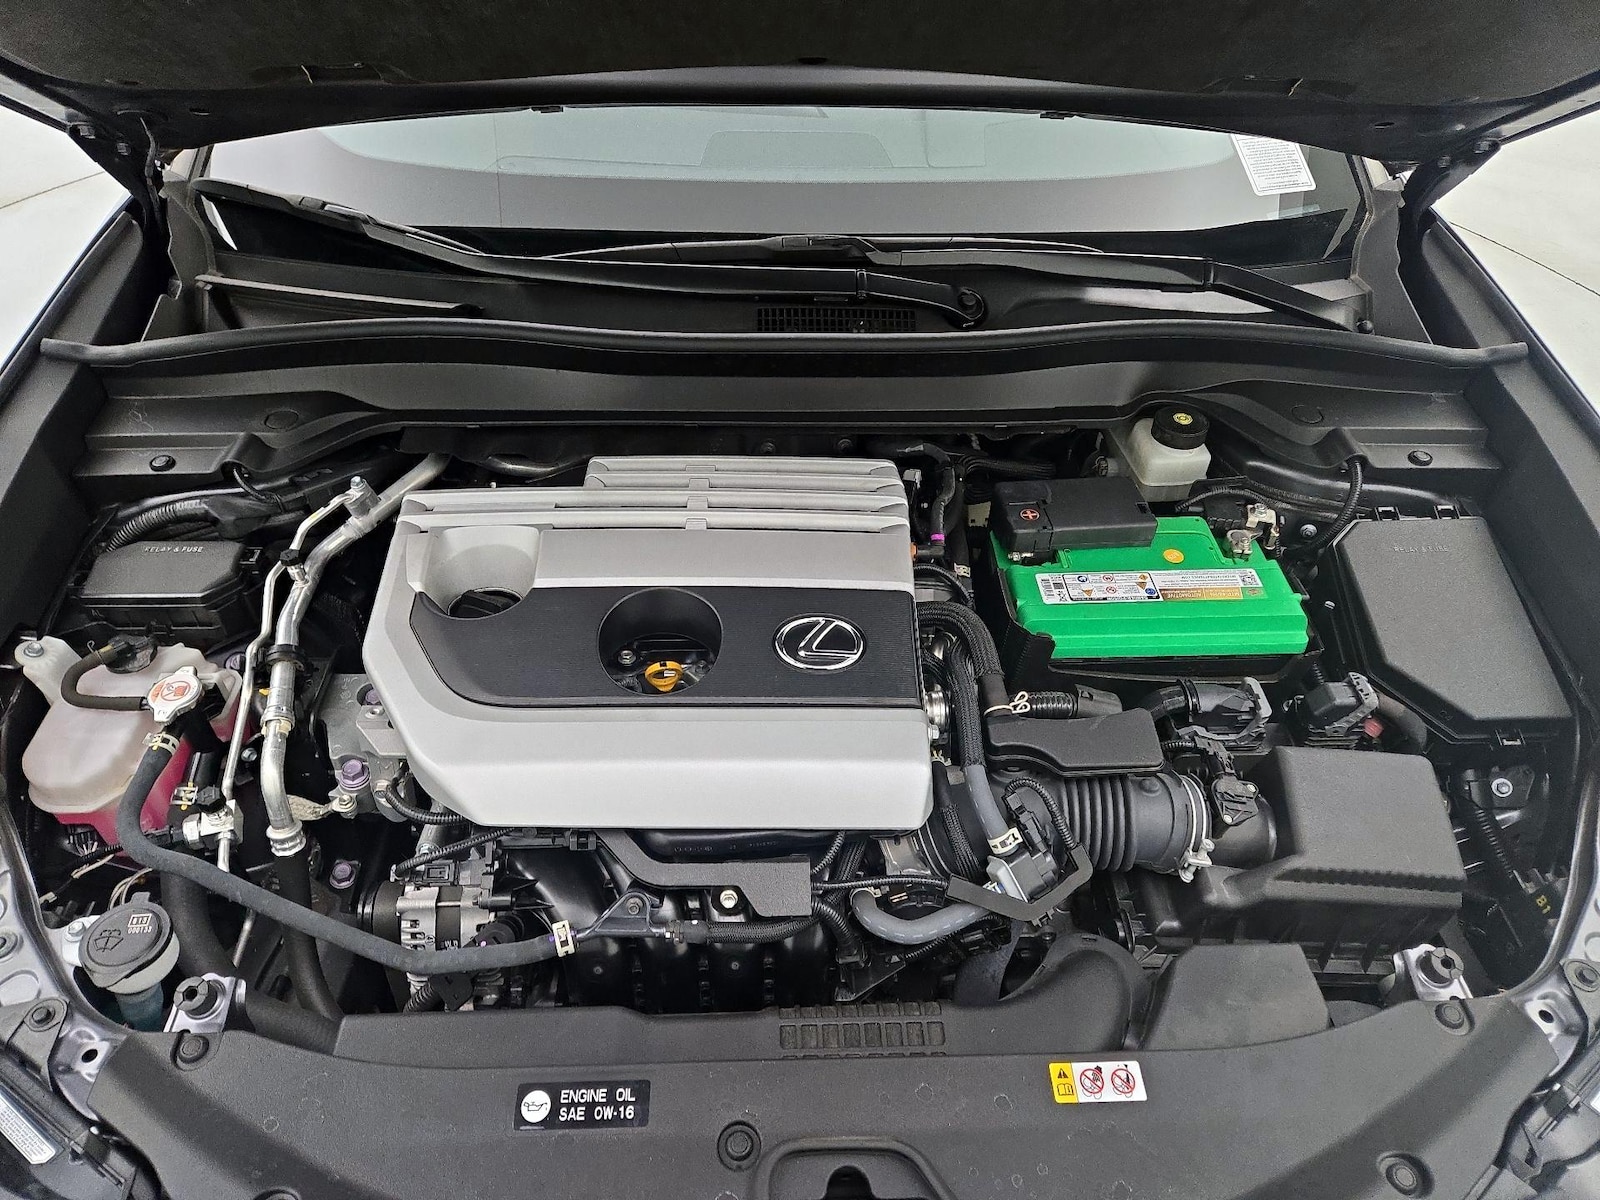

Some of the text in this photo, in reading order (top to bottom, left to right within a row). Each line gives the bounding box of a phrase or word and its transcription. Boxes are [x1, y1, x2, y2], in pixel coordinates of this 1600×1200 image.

[181, 545, 204, 553] FUSE
[560, 1087, 636, 1104] ENGINE OIL
[558, 1105, 635, 1122] SAE 0W-16
